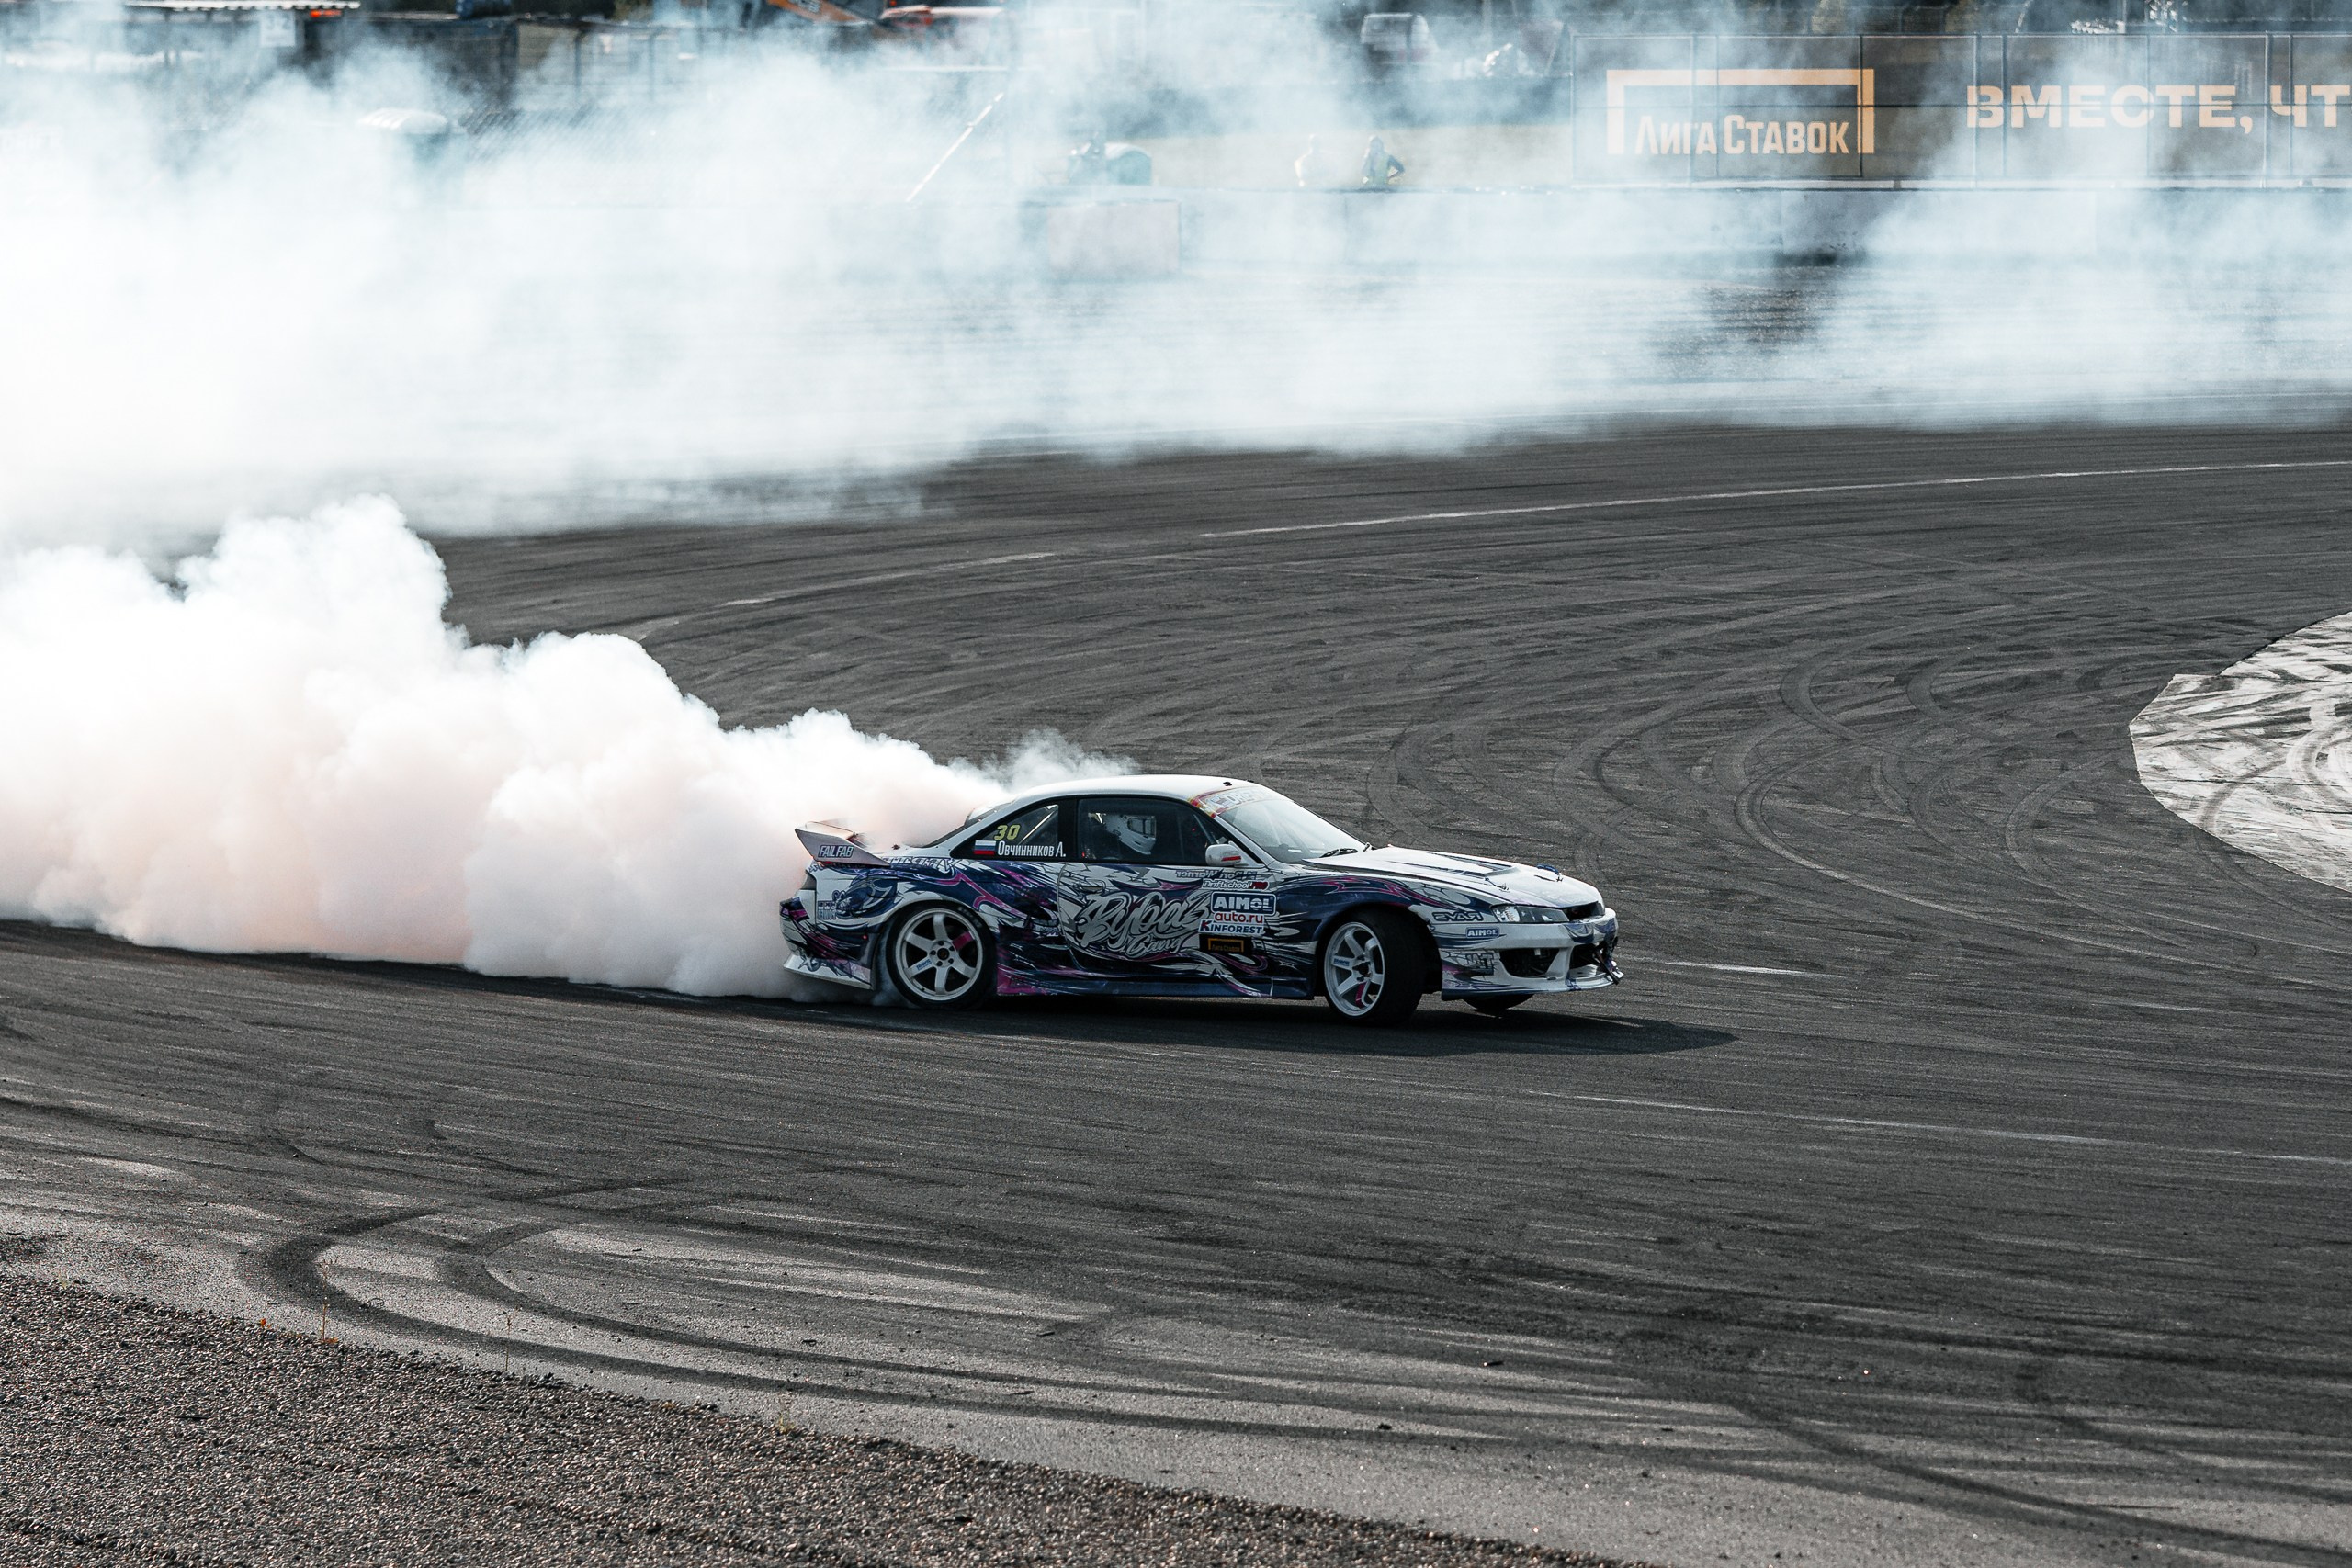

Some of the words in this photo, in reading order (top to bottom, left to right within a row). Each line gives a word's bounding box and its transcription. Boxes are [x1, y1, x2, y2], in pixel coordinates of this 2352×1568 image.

[1966, 85, 2253, 134] ВМЕСТЕ,
[2270, 85, 2352, 128] ЧТ
[994, 825, 1020, 840] 30
[1214, 897, 1273, 911] AIMOL
[1215, 912, 1263, 923] auto.ru
[1200, 920, 1262, 933] KINFOREST
[1467, 929, 1498, 937] AIMOL
